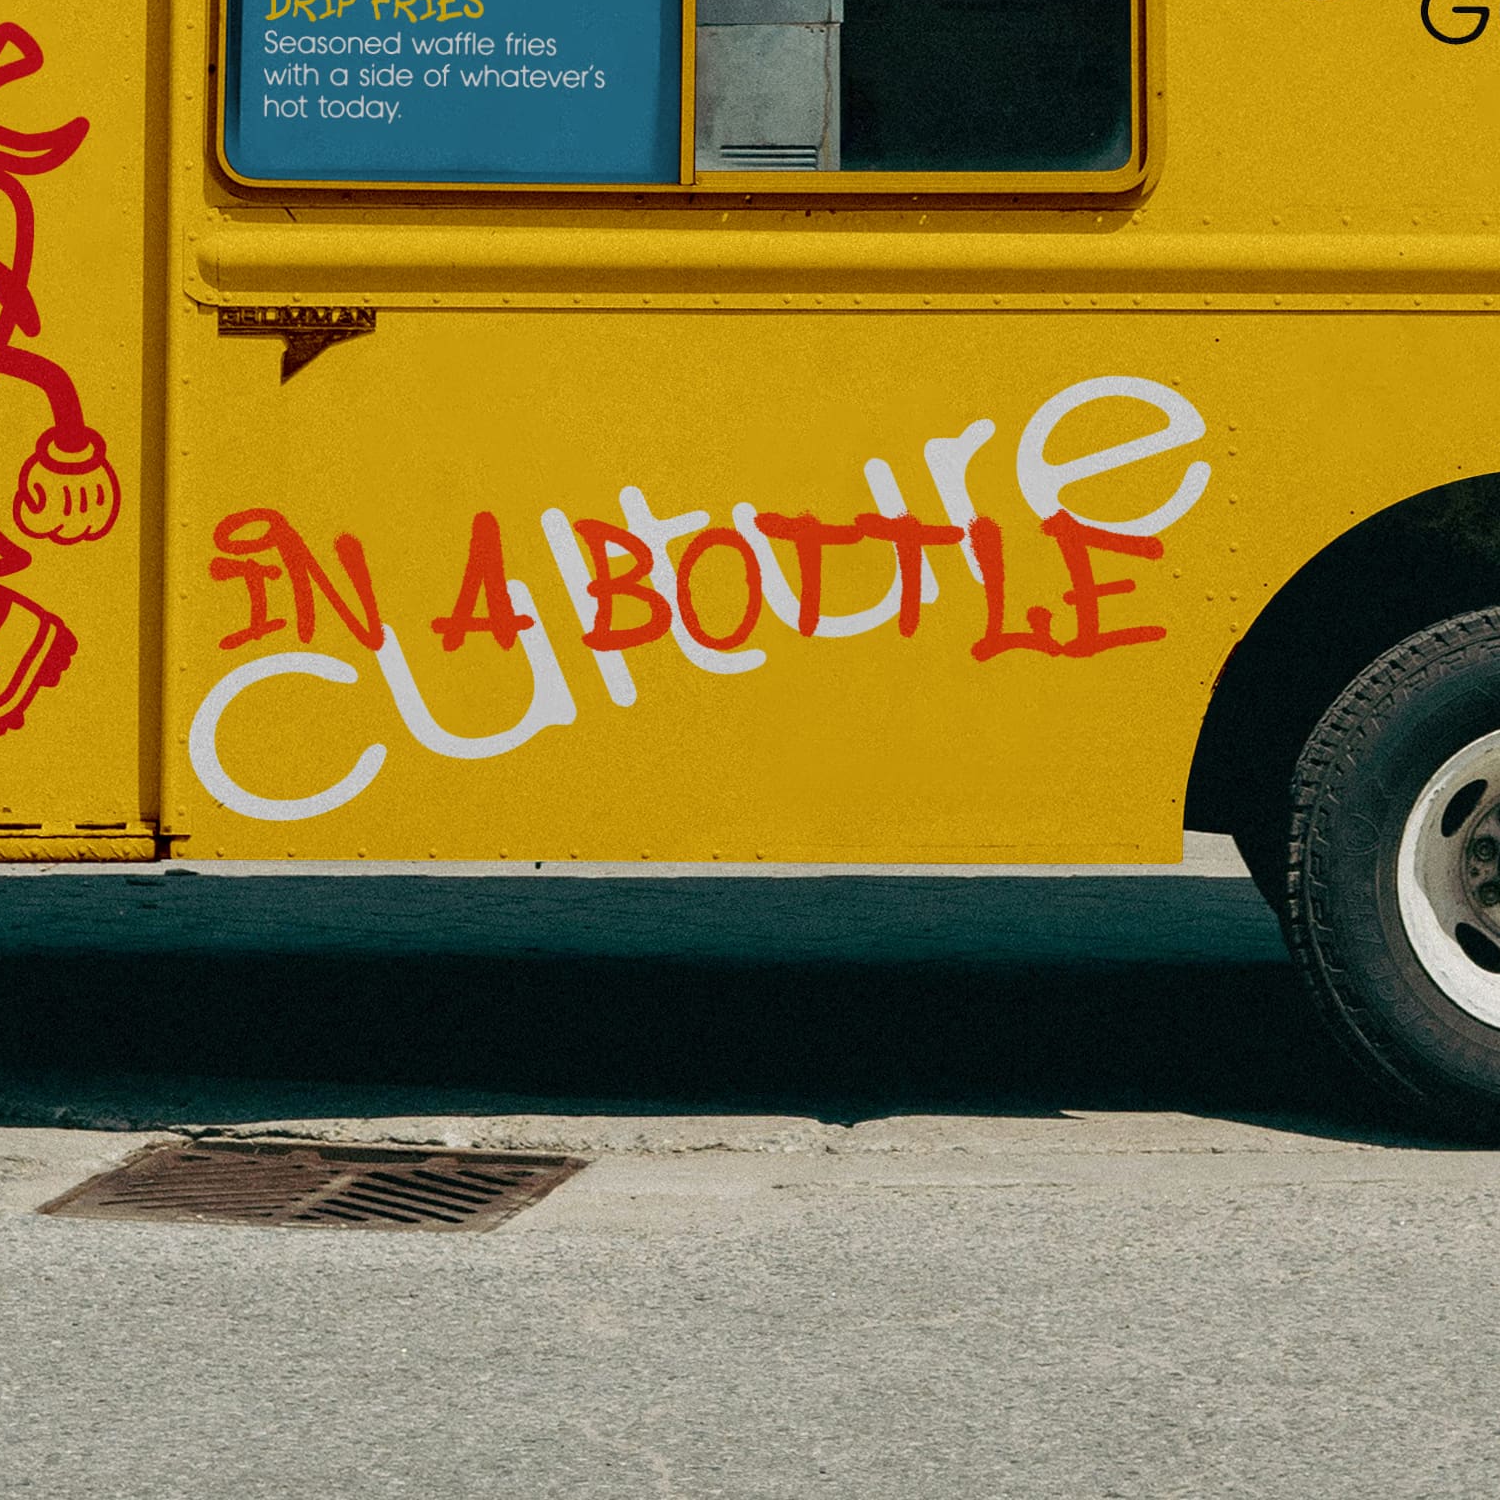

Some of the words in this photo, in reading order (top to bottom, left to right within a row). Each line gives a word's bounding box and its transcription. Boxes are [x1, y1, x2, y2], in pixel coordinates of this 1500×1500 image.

[265, 30, 400, 54] Seasoned
[412, 32, 494, 55] waffle
[506, 33, 556, 56] fries
[264, 64, 318, 86] with
[330, 68, 348, 86] a
[360, 64, 413, 86] side
[424, 64, 450, 87] of
[460, 65, 605, 88] whatever's
[264, 95, 308, 118] hot
[319, 95, 403, 123] today.
[189, 376, 1211, 820] culture
[431, 512, 534, 651] A
[574, 510, 1166, 662] BOTTLE
